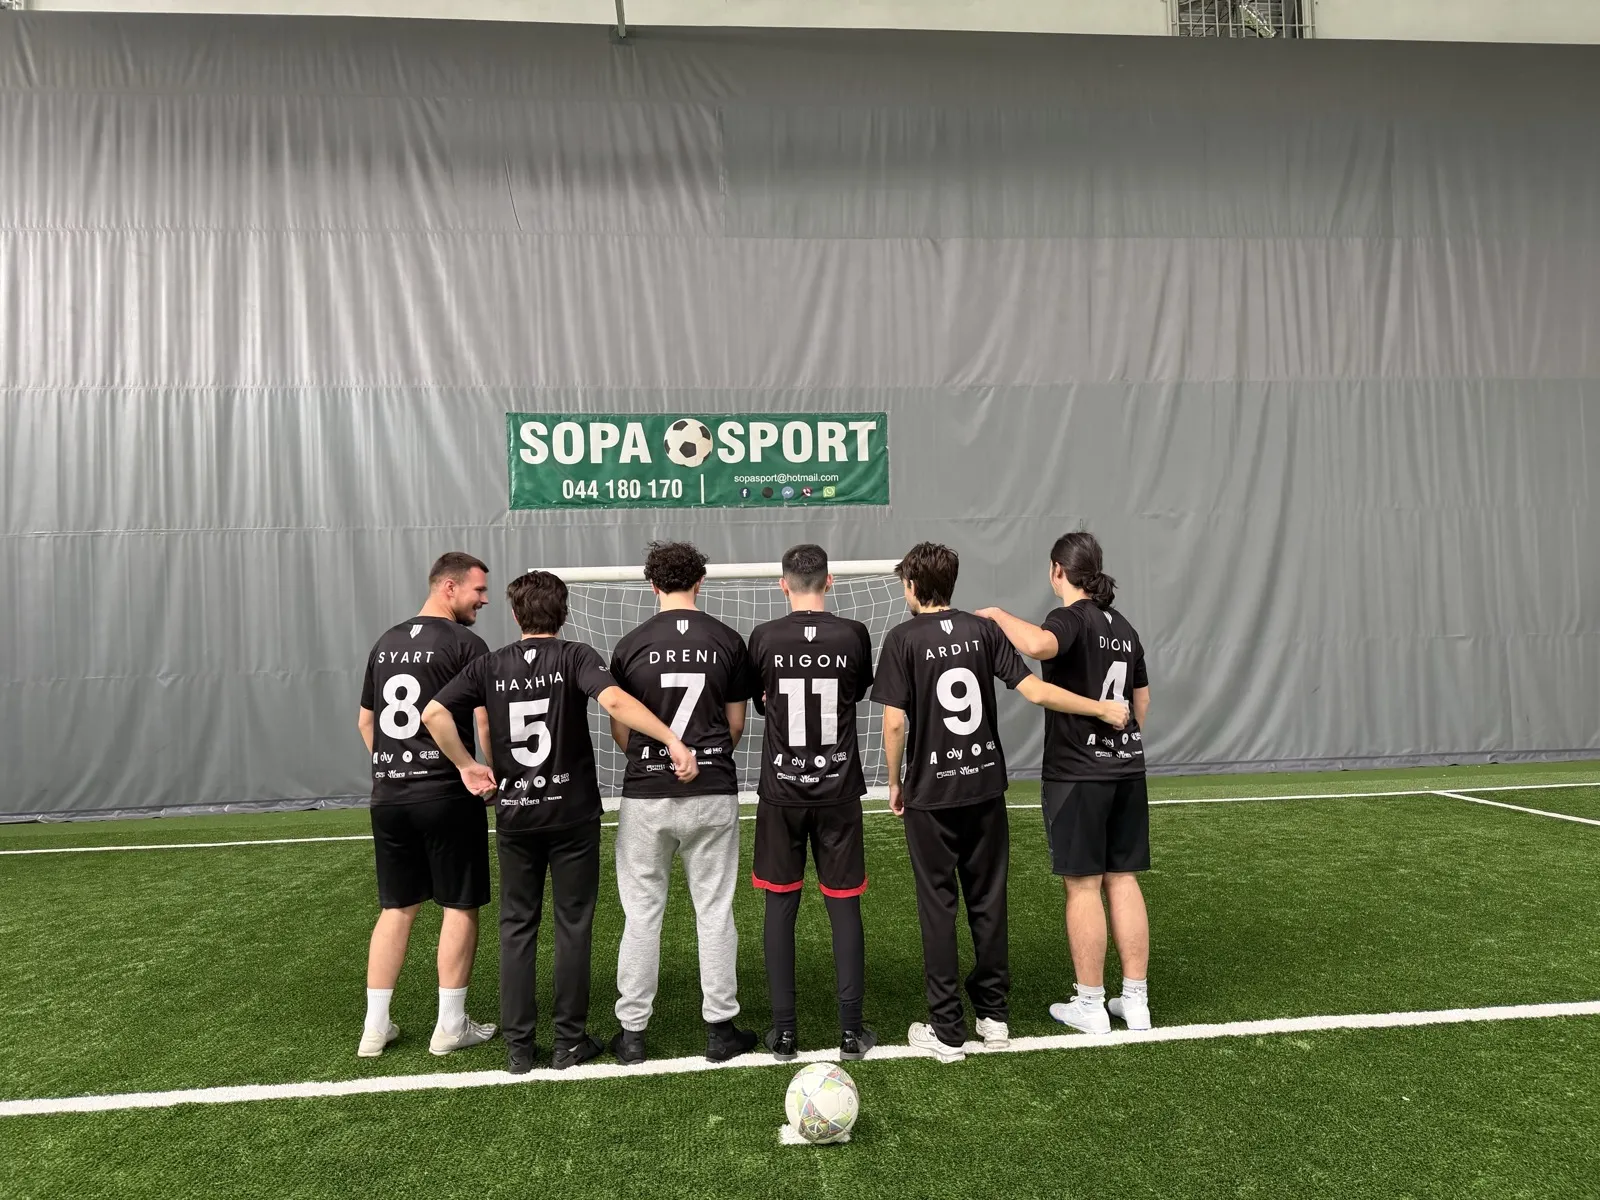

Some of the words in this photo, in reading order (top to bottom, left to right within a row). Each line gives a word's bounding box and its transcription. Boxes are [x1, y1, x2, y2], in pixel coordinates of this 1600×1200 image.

[519, 422, 652, 464] SOPA
[717, 421, 877, 463] SPORT
[562, 479, 599, 499] 044
[605, 479, 641, 498] 180
[647, 479, 683, 499] 170
[733, 473, 839, 484] sopasport@hotmail.com
[925, 640, 980, 661] ARDIT
[1099, 635, 1132, 653] DION
[378, 651, 434, 664] SYART
[649, 649, 717, 664] DRENI
[774, 654, 847, 668] RIGON
[495, 671, 564, 692] HAXHIA
[1098, 660, 1130, 704] 4
[379, 673, 421, 740] 8
[660, 672, 706, 741] 7
[779, 678, 838, 746] 11
[936, 667, 983, 736] 9
[508, 698, 552, 767] 5
